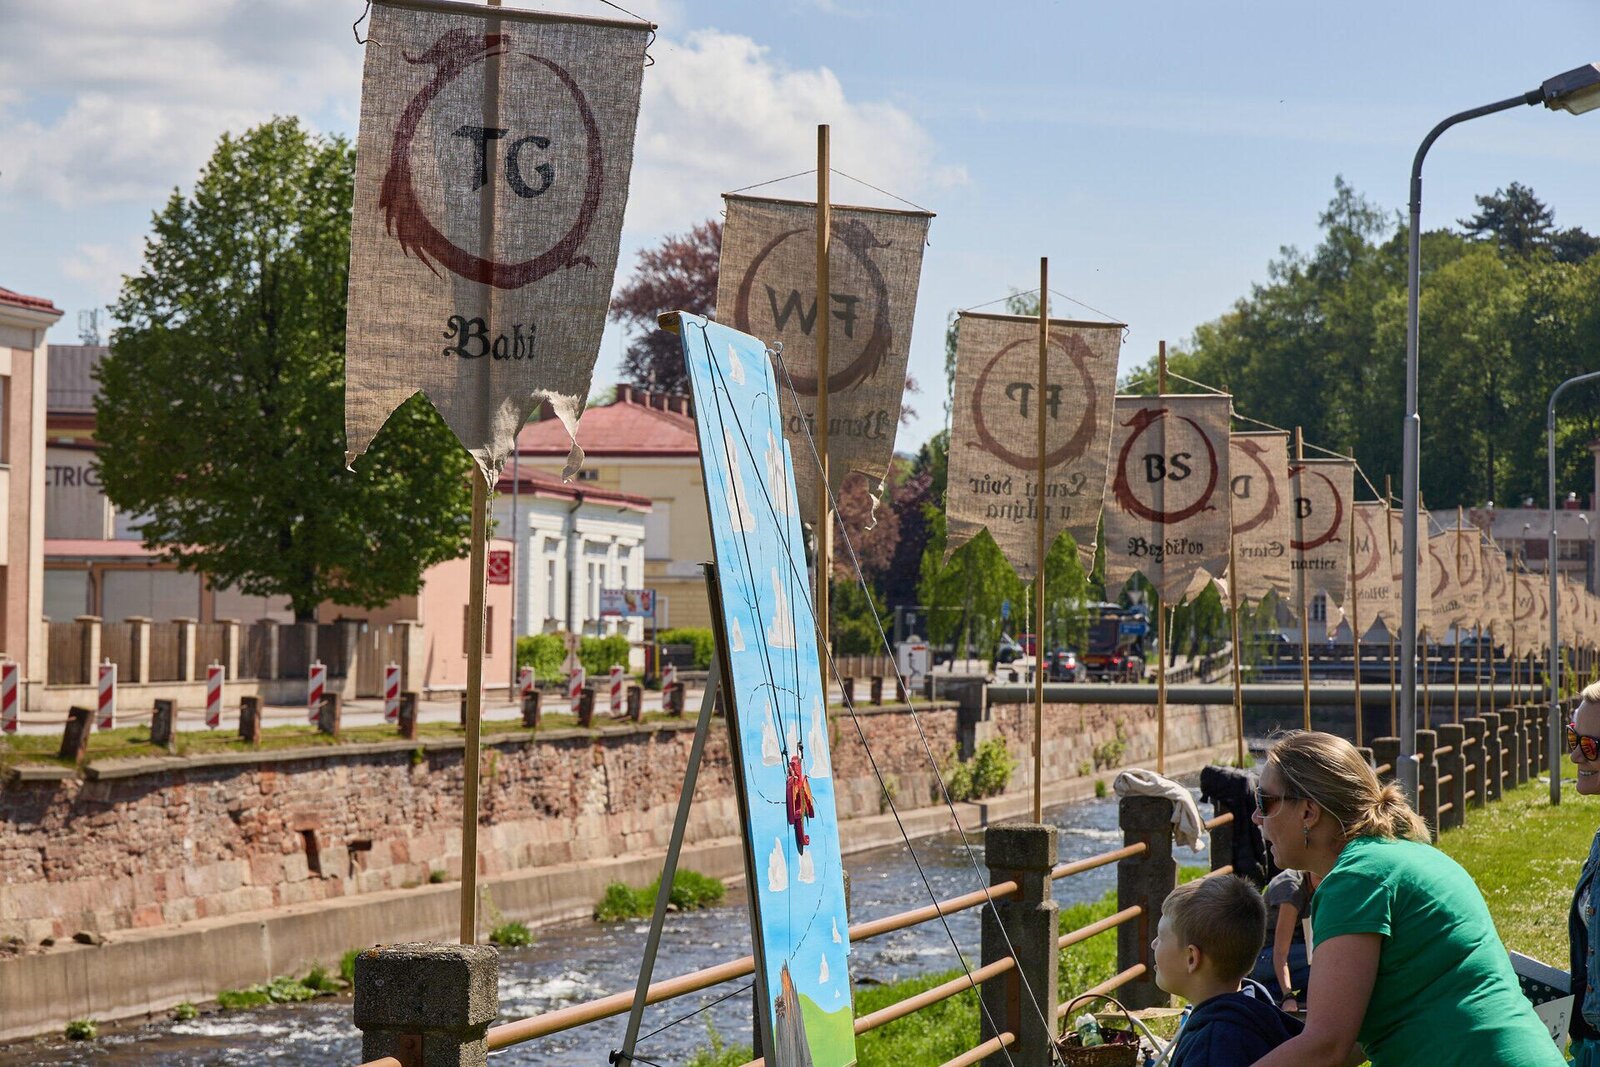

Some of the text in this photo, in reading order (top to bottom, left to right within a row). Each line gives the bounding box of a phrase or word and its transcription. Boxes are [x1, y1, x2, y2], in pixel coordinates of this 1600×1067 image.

[451, 125, 554, 199] TG
[45, 465, 105, 488] TRIC
[1141, 452, 1192, 483] BS
[1295, 497, 1312, 519] B
